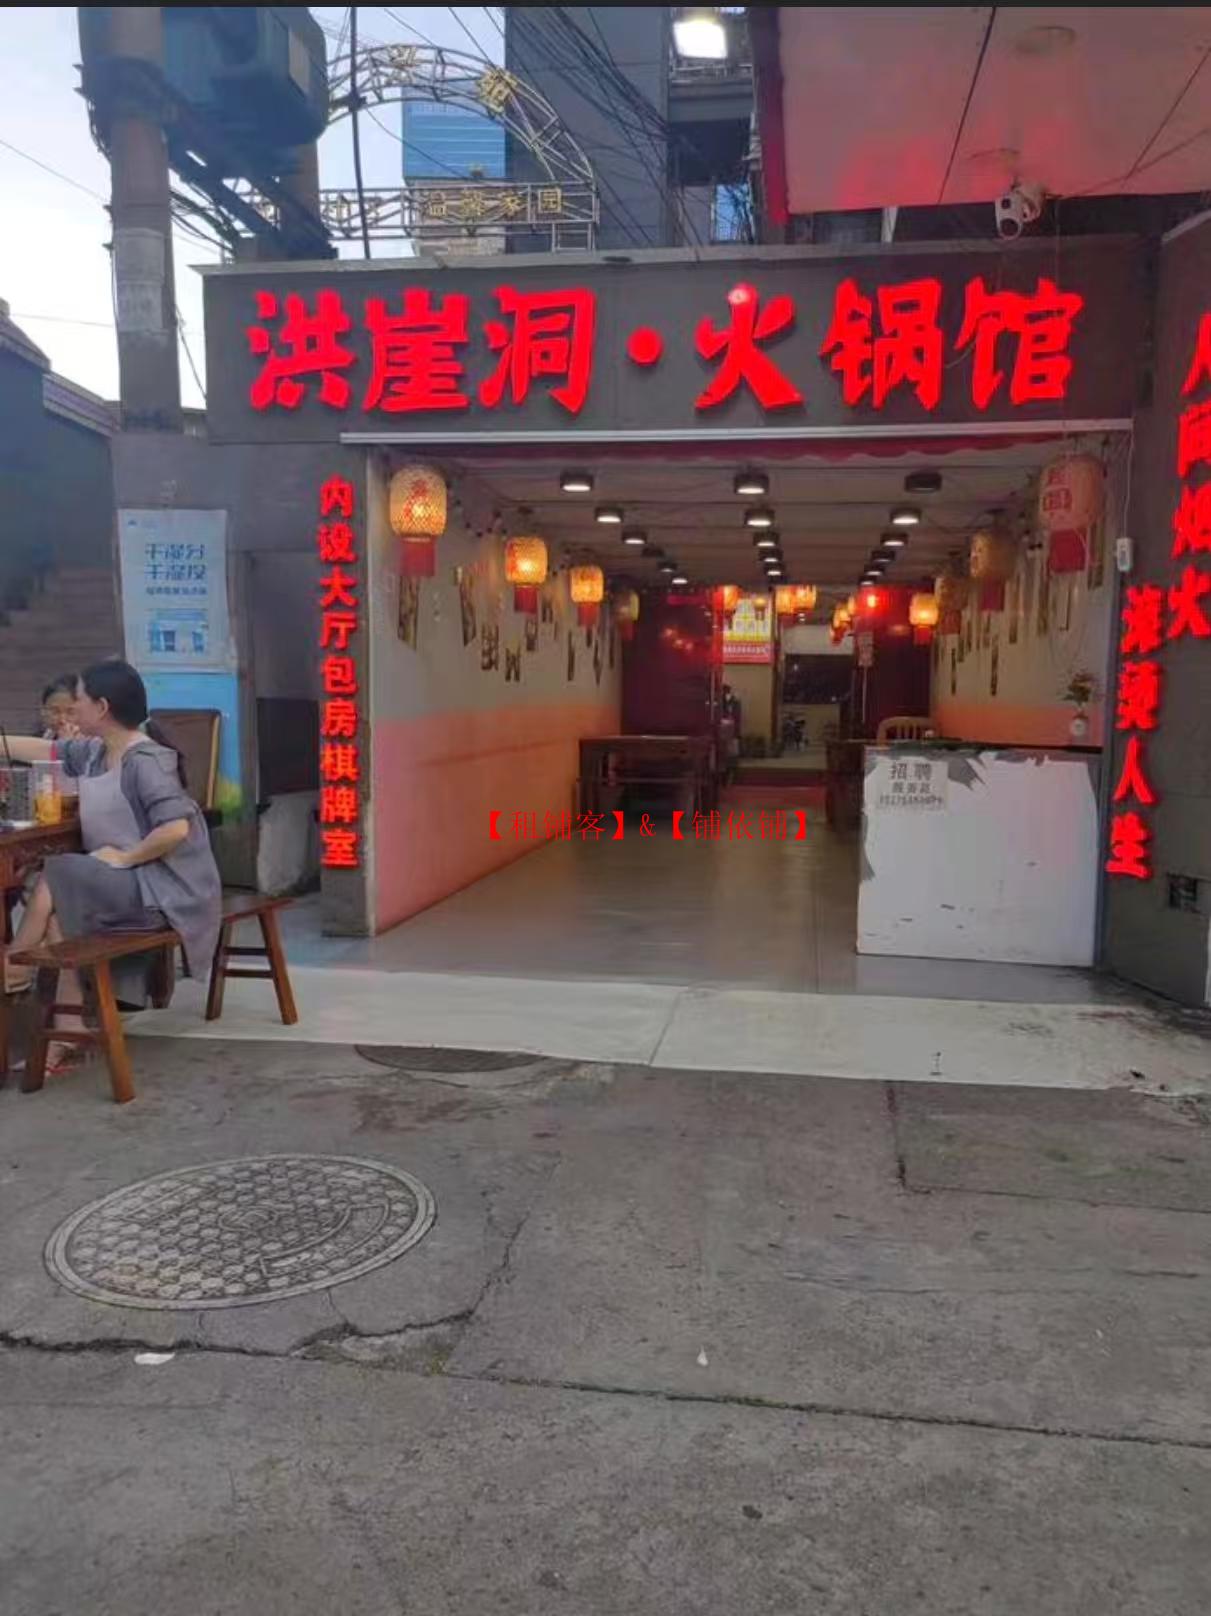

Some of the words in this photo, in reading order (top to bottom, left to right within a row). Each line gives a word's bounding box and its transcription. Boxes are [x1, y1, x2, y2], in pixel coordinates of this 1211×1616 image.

[247, 278, 1084, 413] 洪崖洞·火锅馆
[318, 476, 358, 867] 内设大厅包房棋牌室
